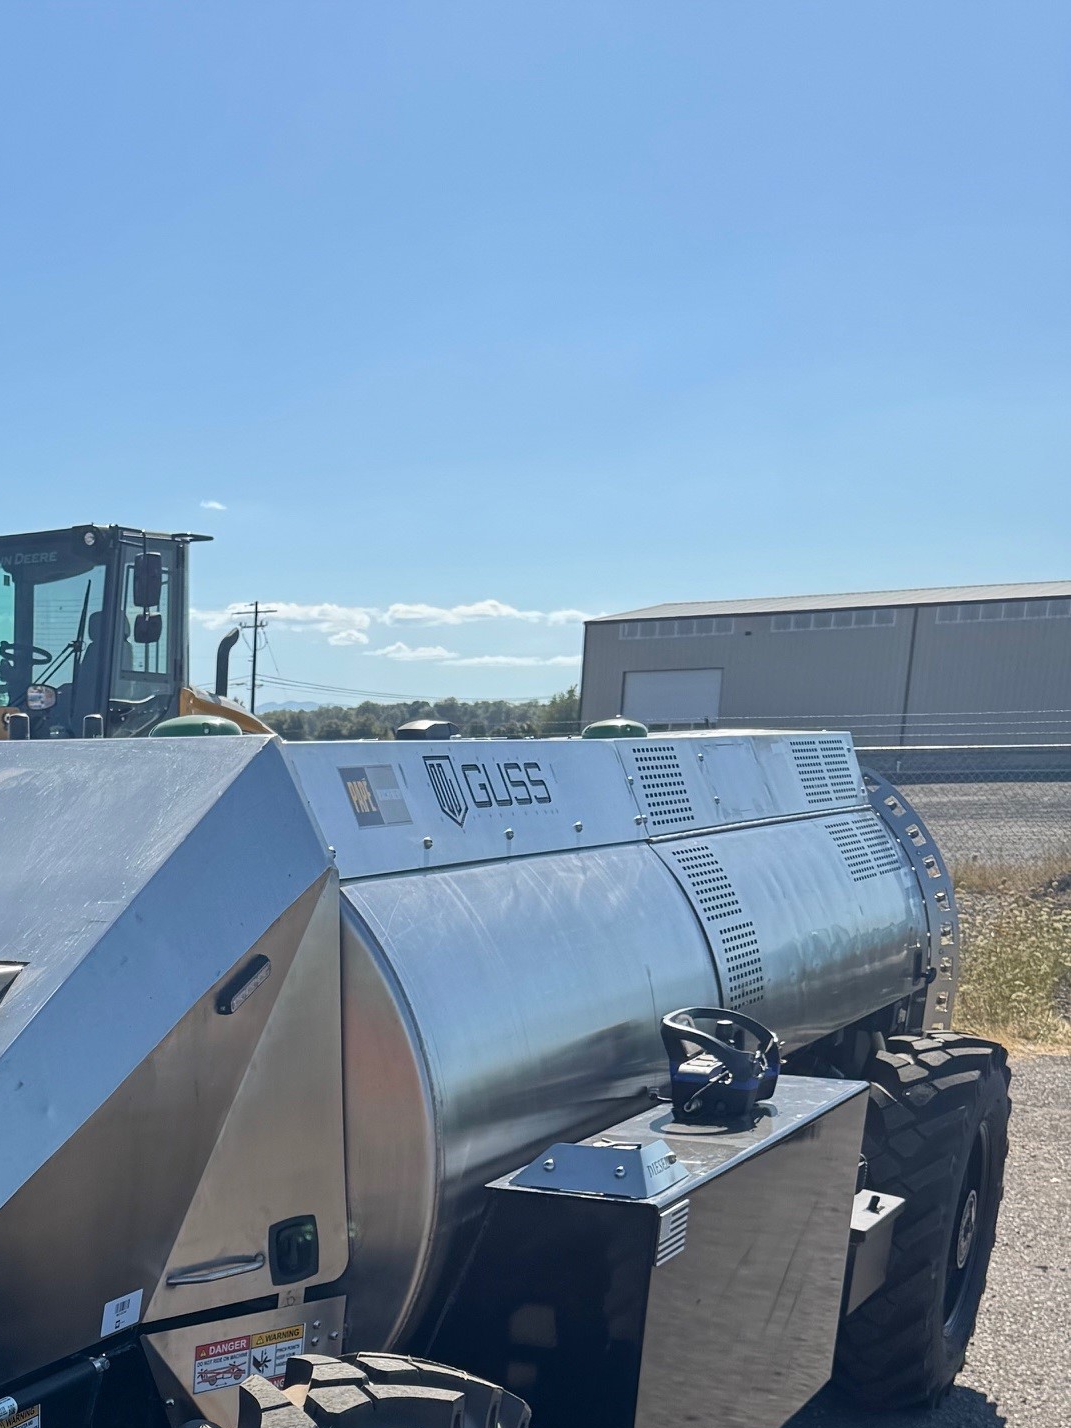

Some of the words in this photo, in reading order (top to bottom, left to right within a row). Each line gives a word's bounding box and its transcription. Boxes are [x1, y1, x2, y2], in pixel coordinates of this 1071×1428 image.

[14, 551, 59, 565] DEERE
[461, 762, 552, 808] GUSS
[265, 1328, 300, 1342] WARNING
[209, 1339, 247, 1355] DANGER
[6, 1408, 35, 1427] WARNING
